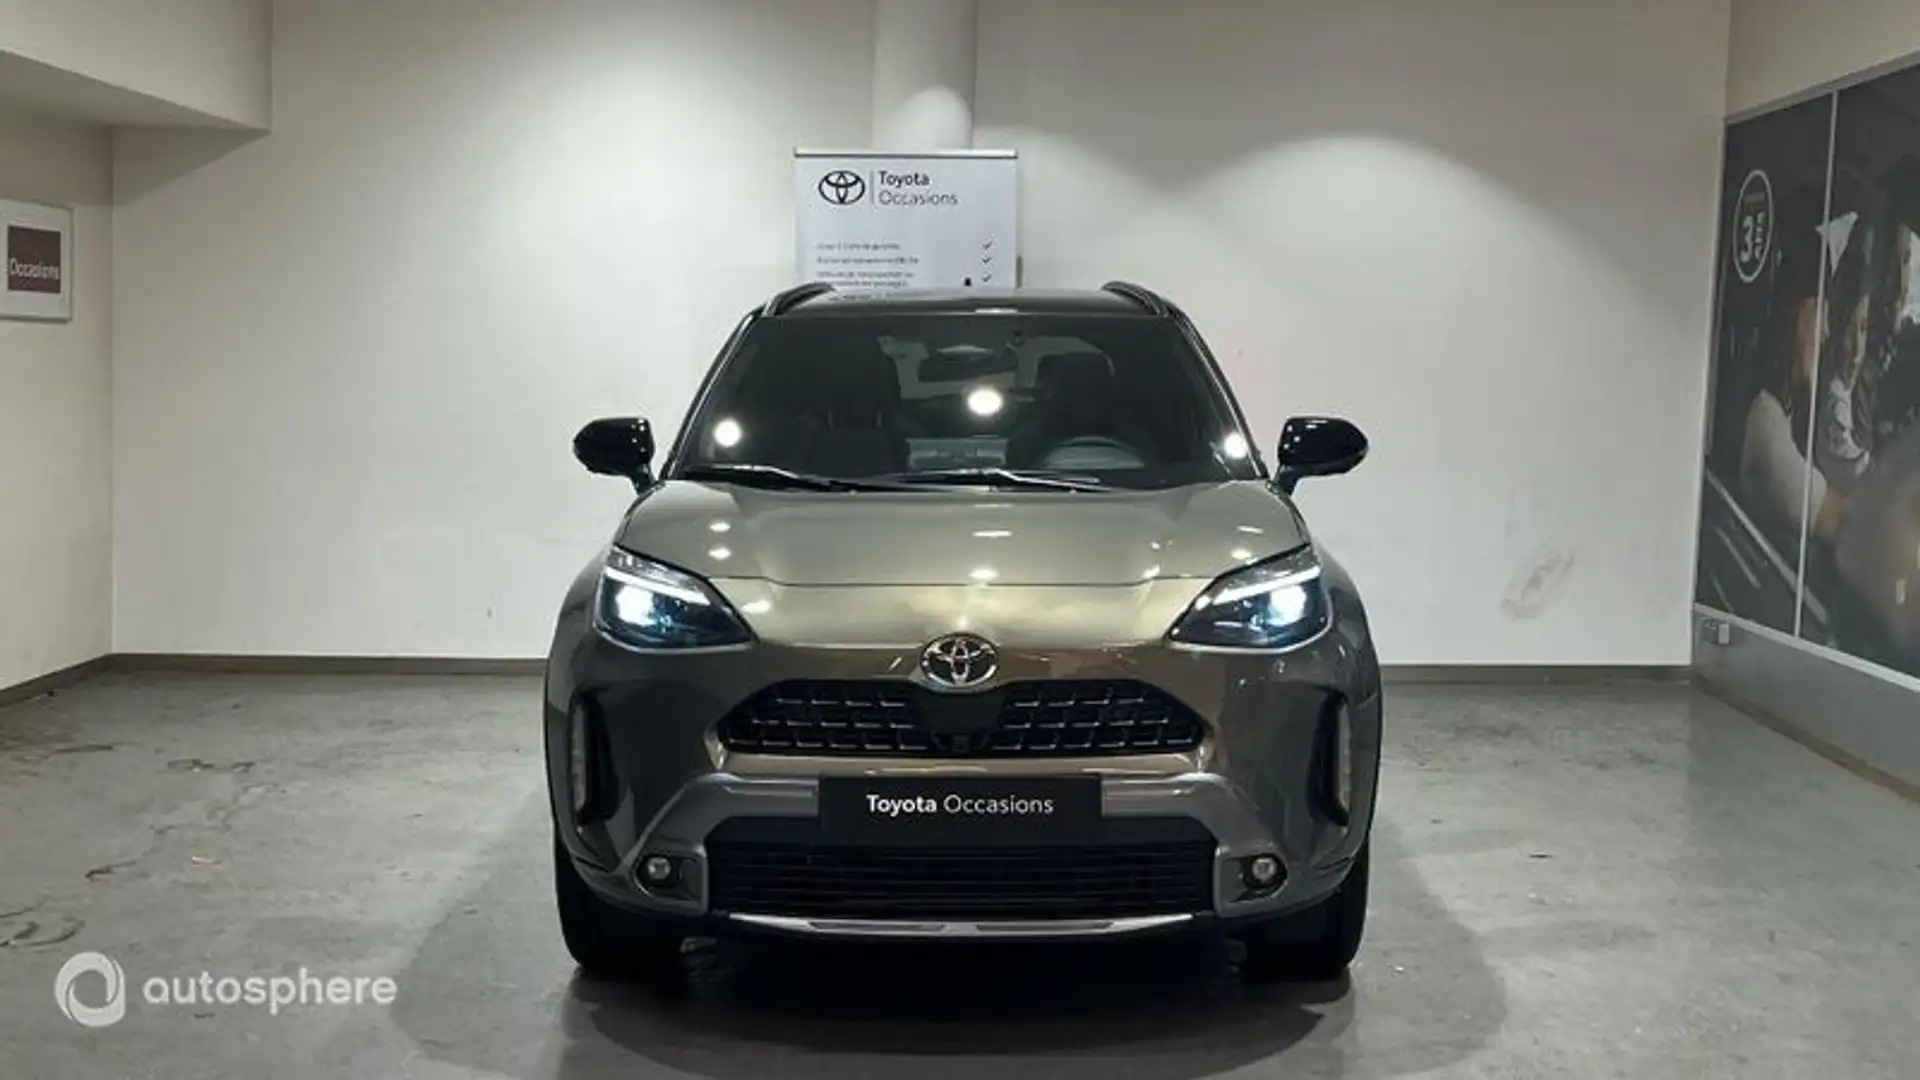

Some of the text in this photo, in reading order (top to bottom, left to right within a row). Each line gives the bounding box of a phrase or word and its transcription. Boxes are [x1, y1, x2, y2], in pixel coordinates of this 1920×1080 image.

[878, 171, 930, 188] Toyota
[878, 189, 958, 206] Occasions
[866, 794, 1054, 817] Toyota Occasions
